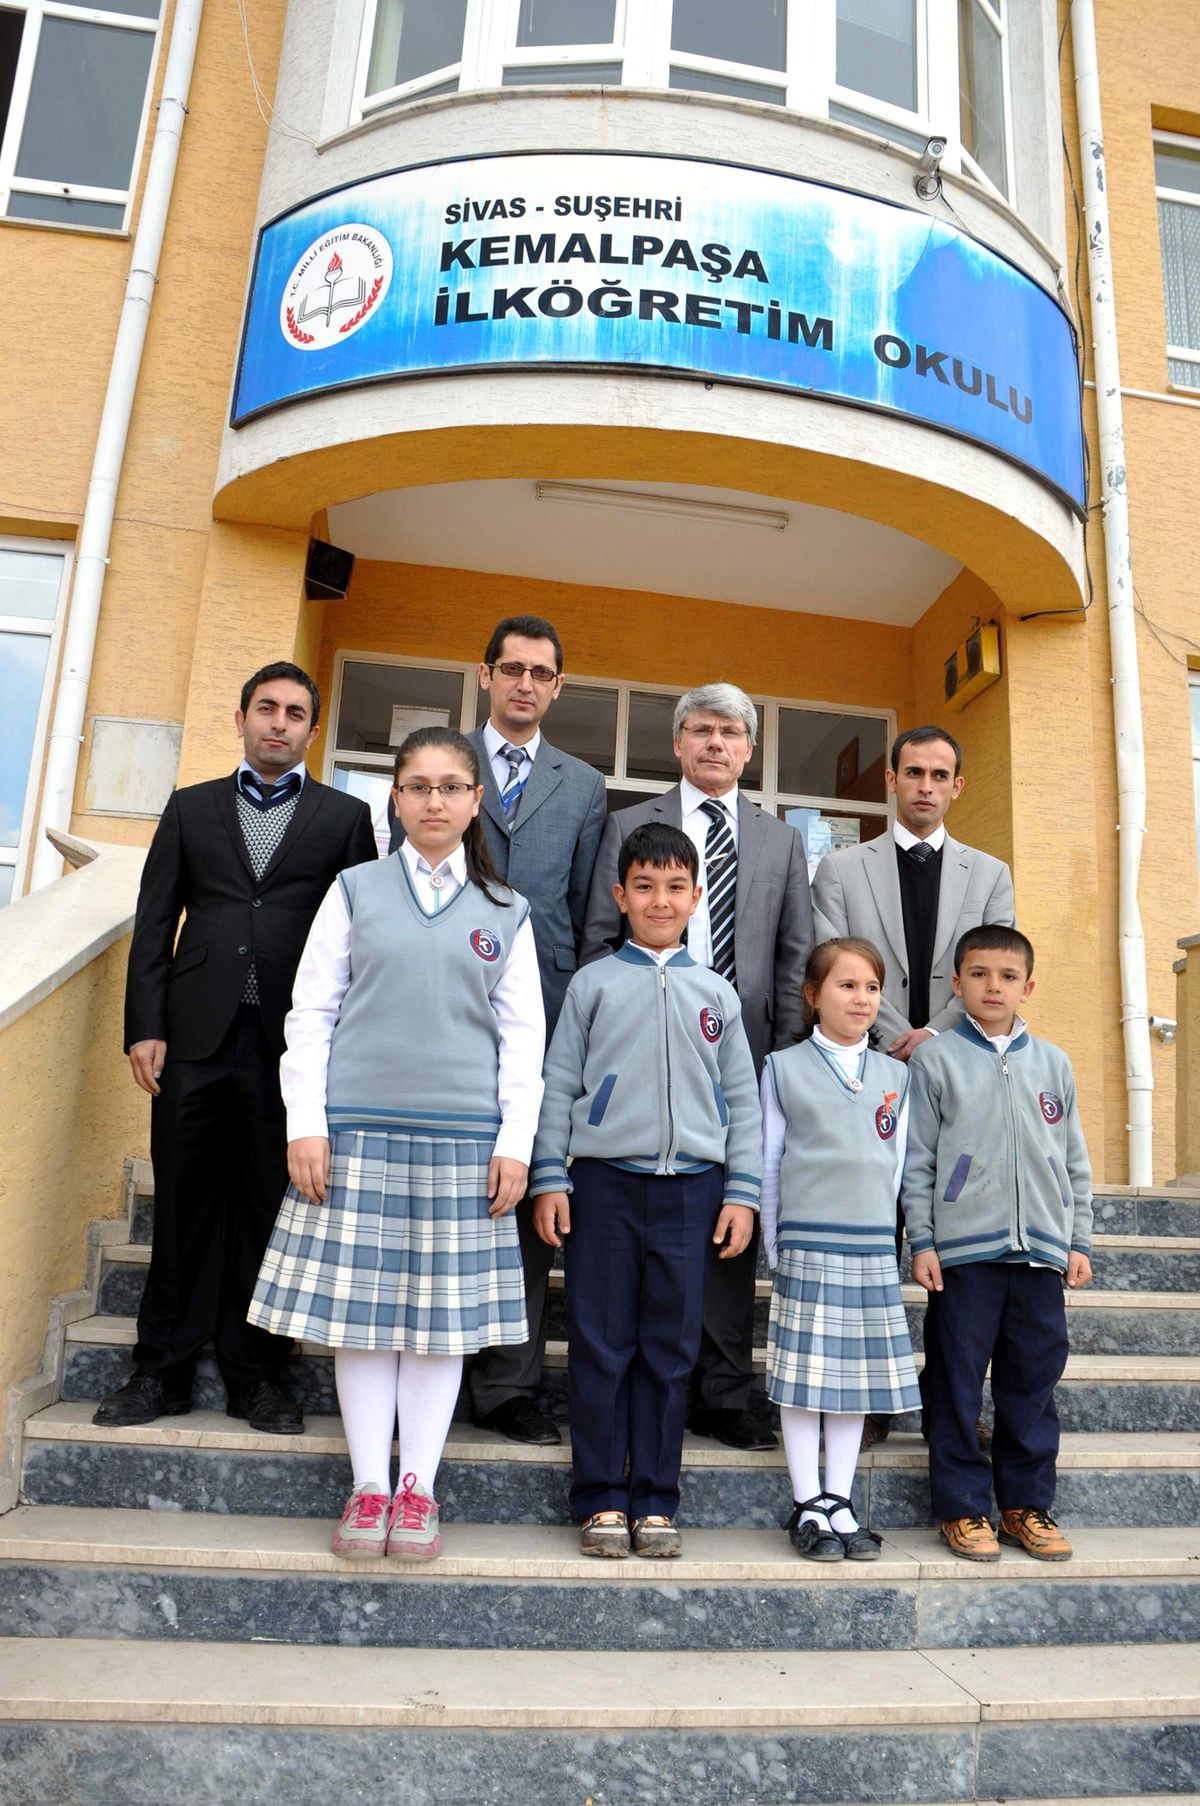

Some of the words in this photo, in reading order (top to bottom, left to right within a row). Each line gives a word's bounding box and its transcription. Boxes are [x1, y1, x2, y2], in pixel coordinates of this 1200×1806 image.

[444, 197, 526, 225] SİVAS
[554, 195, 682, 223] SUŞEHRİ
[319, 233, 350, 252] EĞİTİM
[351, 233, 383, 269] BAKANLIĞI
[440, 233, 768, 283] KEMALPAŞA
[434, 279, 833, 351] İLKÖĞRETİM
[874, 334, 1033, 425] OKULU
